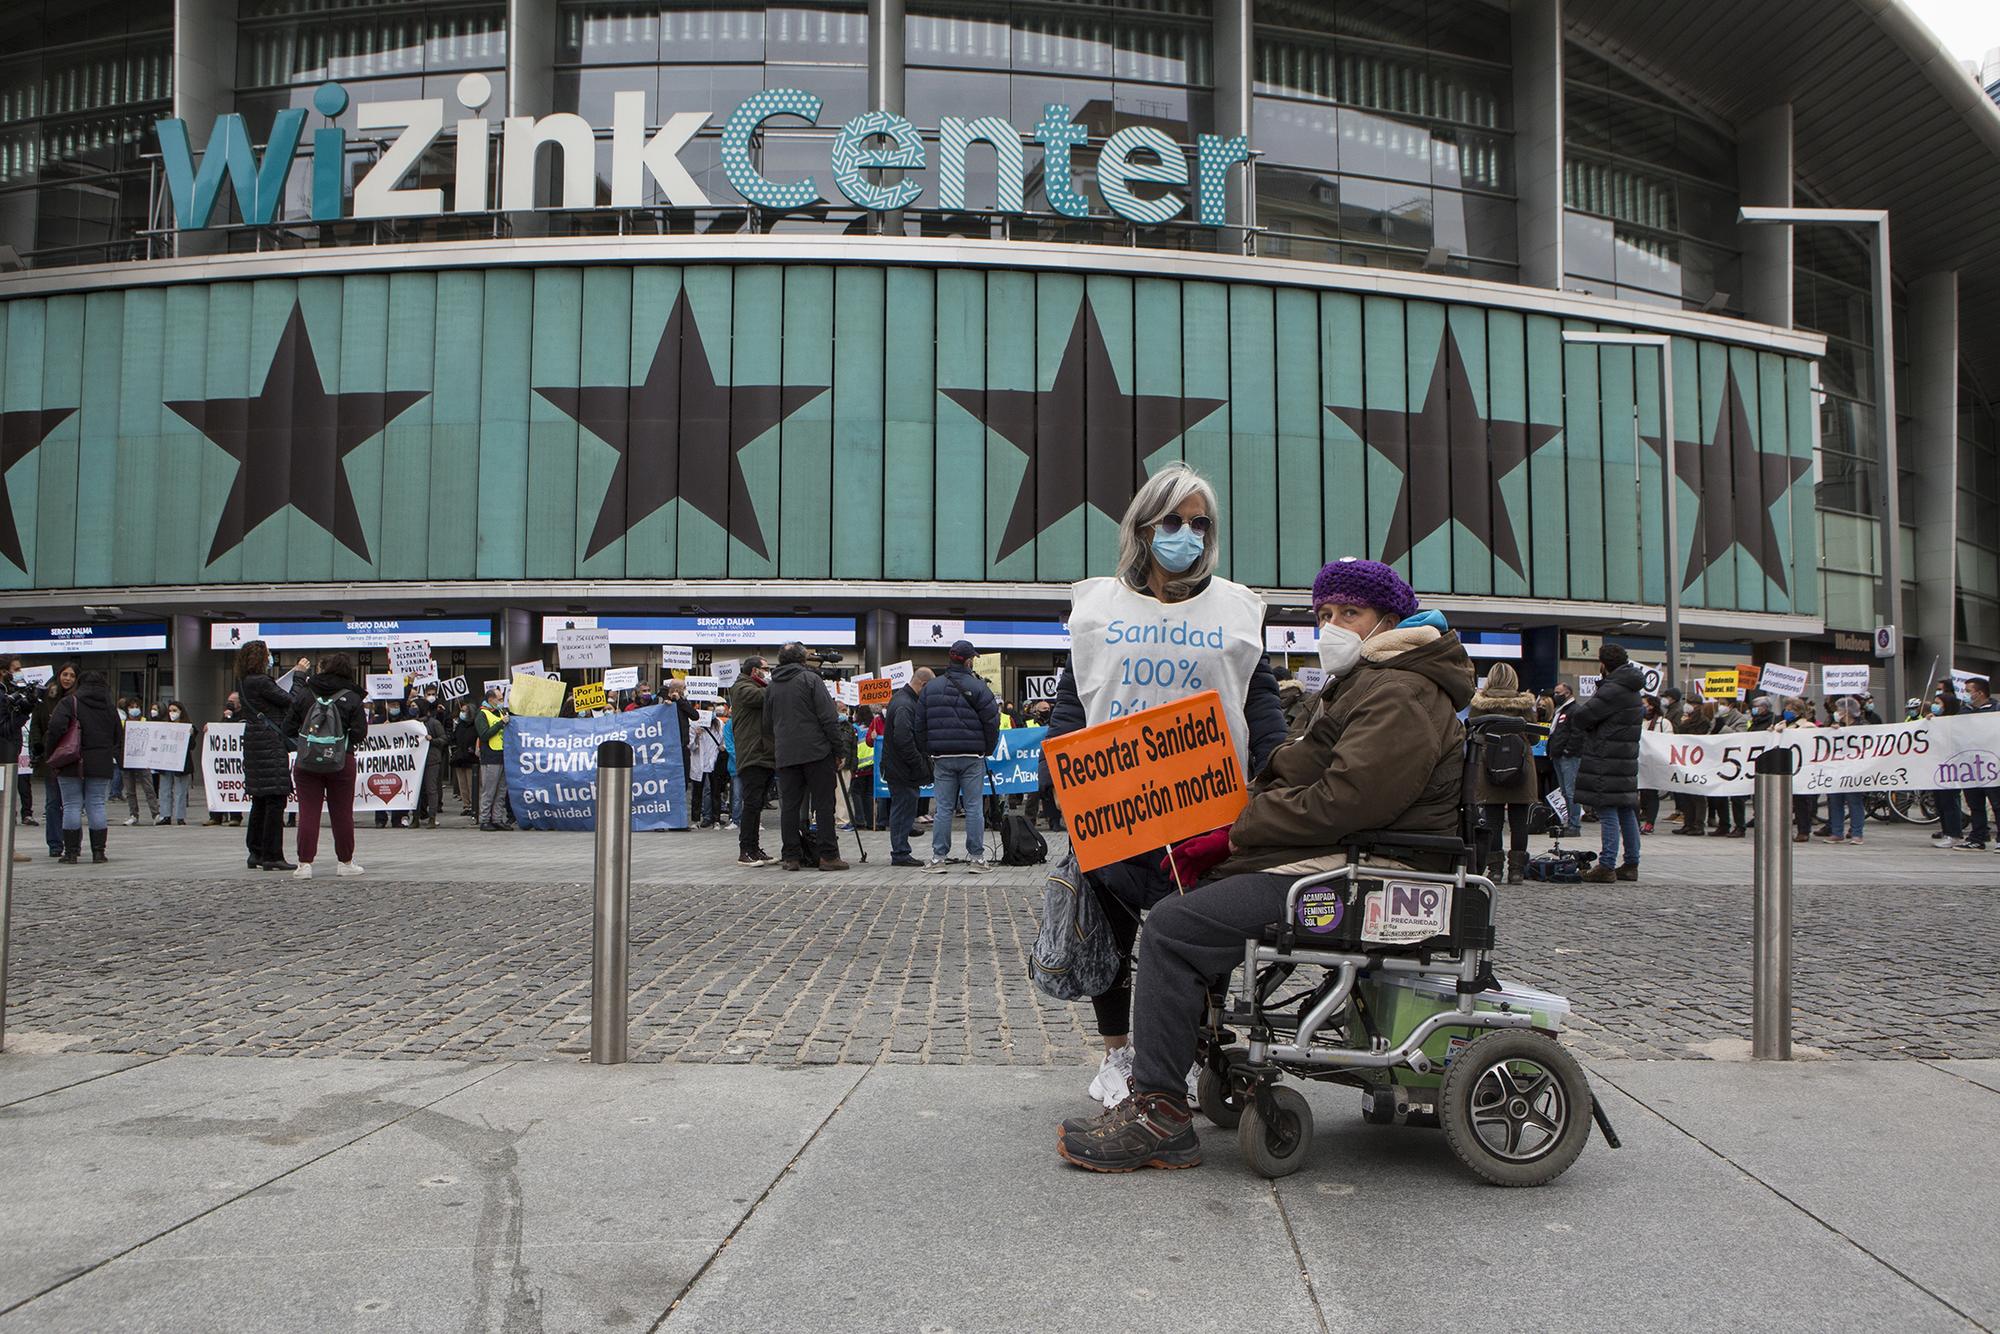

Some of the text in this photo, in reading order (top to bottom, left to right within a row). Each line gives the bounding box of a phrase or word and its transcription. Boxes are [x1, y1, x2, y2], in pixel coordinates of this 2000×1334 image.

[721, 88, 1248, 226] Center
[347, 621, 399, 630] SERGIO DALMA
[697, 617, 755, 626] SERGIO DALMA
[50, 627, 93, 636] SERGIO DALMA
[1105, 618, 1224, 650] Sanidad
[397, 651, 428, 660] DESMANTELA
[405, 658, 429, 666] SANIDAD
[698, 653, 710, 661] 02
[1121, 657, 1202, 690] 100%
[442, 678, 466, 698] NO
[575, 688, 593, 698] ¡Por
[1028, 677, 1056, 697] NO
[575, 695, 605, 707] SALUD!
[862, 691, 891, 700] ABUSO!
[210, 734, 220, 751] NO
[222, 739, 228, 751] a
[229, 734, 237, 751] la
[394, 737, 404, 746] en
[405, 732, 420, 748] los
[518, 721, 662, 751] Trabajadores del
[1056, 737, 1140, 790] Recortar
[1142, 706, 1226, 762] Sanidad,
[1810, 730, 1930, 763] DESPIDOS
[1016, 750, 1028, 759] DE
[1670, 744, 1704, 765] NO
[214, 758, 244, 774] CENTR
[367, 754, 416, 773] PRIMARIA
[519, 751, 598, 775] SUMM
[1938, 754, 1998, 783] mats
[1670, 772, 1679, 783] A
[1684, 774, 1708, 784] LOS
[1807, 768, 1909, 789] ¿te mueves?
[220, 793, 226, 802] Y
[228, 793, 239, 802] EL
[523, 787, 549, 804] en
[631, 779, 668, 797] por
[1074, 756, 1238, 842] corrupción mortal!
[528, 810, 540, 820] la
[544, 807, 592, 819] calidad
[1302, 893, 1336, 902] ACAMPADA
[1303, 906, 1335, 916] FEMINISTA
[1304, 917, 1317, 927] SOL
[1391, 917, 1438, 926] PRECARIEDAD
